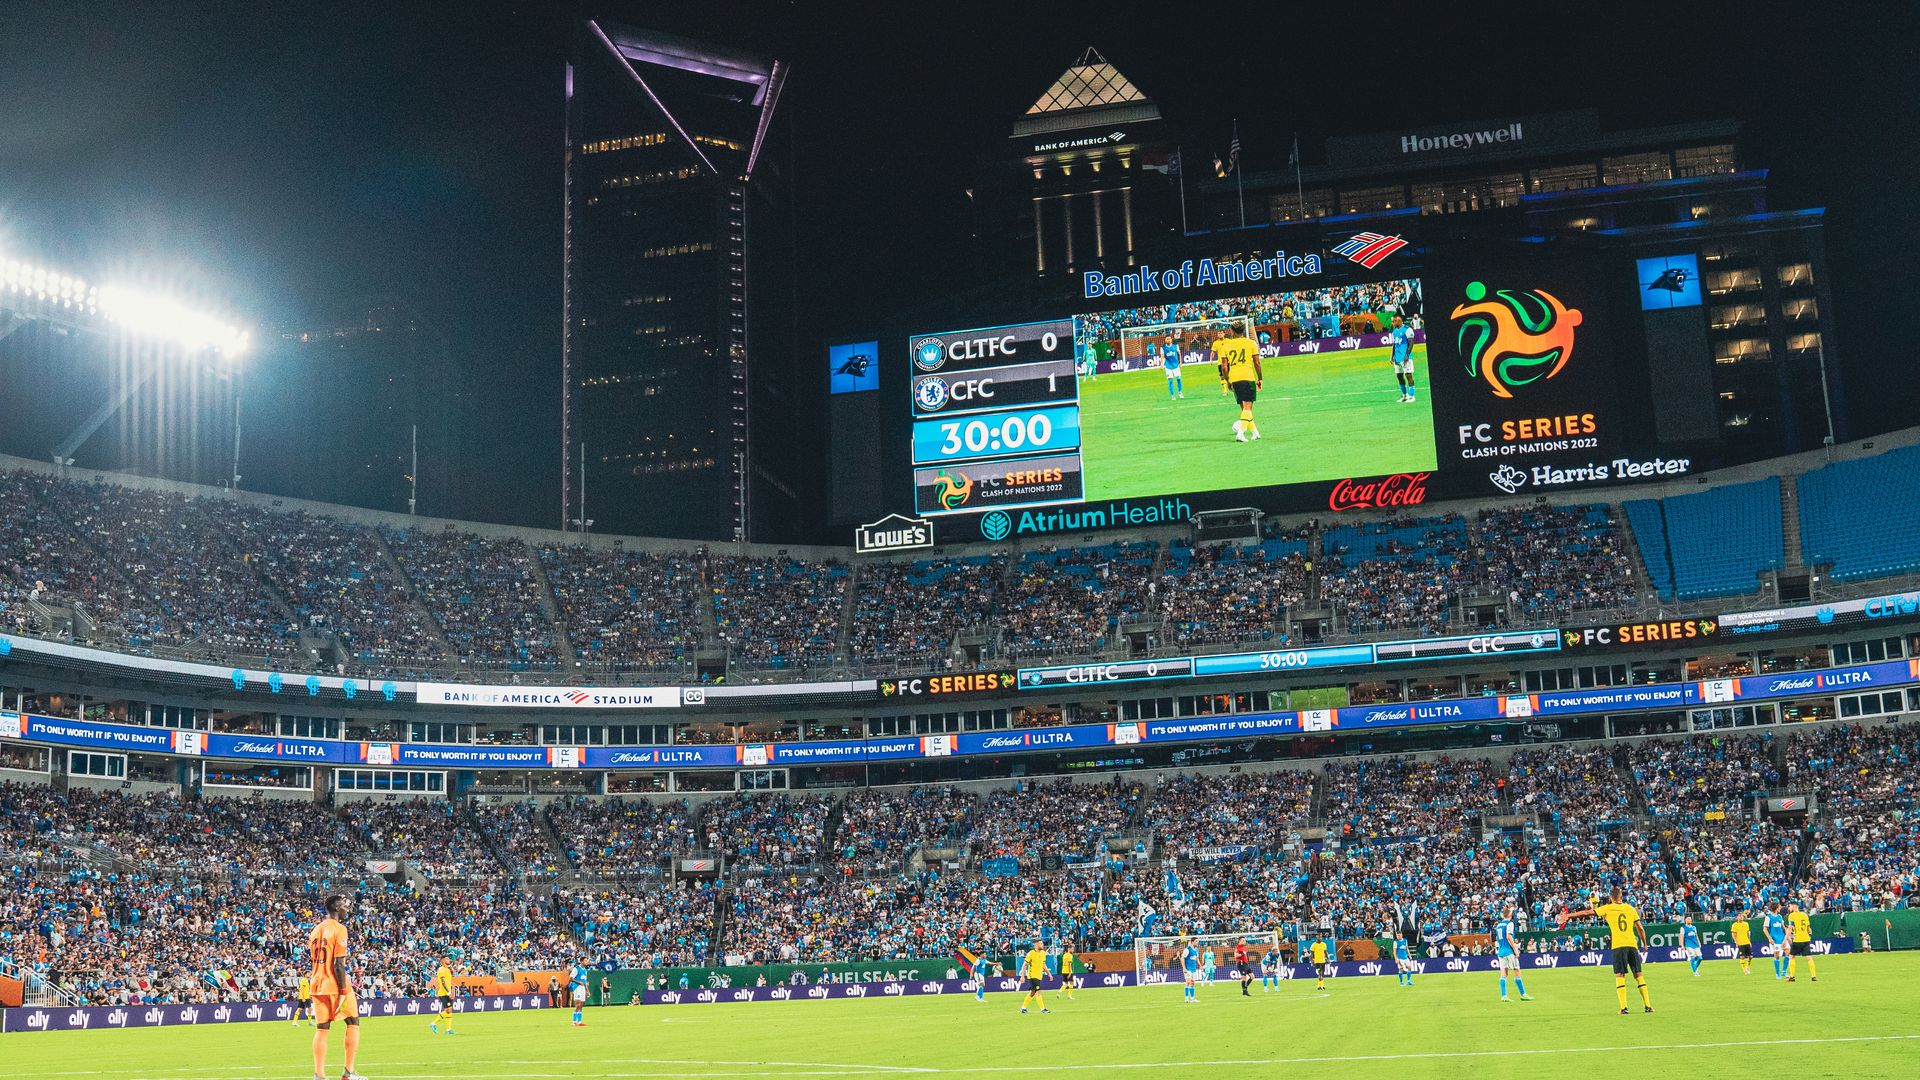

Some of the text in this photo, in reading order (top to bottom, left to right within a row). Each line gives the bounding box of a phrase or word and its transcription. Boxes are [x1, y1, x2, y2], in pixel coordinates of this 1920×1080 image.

[1035, 142, 1057, 151] BANK
[1071, 137, 1108, 147] AMERICA
[1401, 123, 1523, 152] Honeywell
[1084, 250, 1321, 298] Bank of America
[1322, 328, 1333, 338] FC
[948, 332, 1058, 360] CLTFC 0
[1299, 341, 1320, 353] ally
[1339, 336, 1361, 350] ally
[1184, 351, 1204, 363] ally
[1228, 348, 1246, 366] 24
[1111, 359, 1130, 371] ally
[950, 372, 1057, 400] CFC 1
[940, 414, 1052, 455] 30:00
[1459, 413, 1596, 445] FC SERIES
[1462, 438, 1598, 459] CLASH OF NATIONS 2022
[980, 468, 1063, 487] FC SERIES
[1532, 456, 1690, 486] Harris Teeter
[981, 484, 1063, 498] CLASH OF NATIONS 2022
[1329, 472, 1432, 511] Coca-Cola
[1017, 498, 1191, 535] Atrium Health
[1737, 618, 1765, 626] LOCATION
[1584, 620, 1697, 645] FC SERIES
[1411, 636, 1505, 657] 1 CFC
[1260, 652, 1308, 668] 30:00
[1066, 662, 1157, 683] CLTFC 0
[898, 674, 998, 695] FC SERIES
[1769, 672, 1872, 692] Michelob ULTRA
[444, 691, 653, 705] BANK OF AMERICA STADIUM
[685, 690, 703, 702] CC
[1544, 689, 1693, 708] IT'S ONLY WORTH IT IF YOU ENJOY IT
[1365, 706, 1462, 722] Michelob ULTRA
[1152, 726, 1165, 734] IT'S
[1167, 725, 1187, 734] ONLY
[1188, 723, 1218, 732] WORTH
[1228, 722, 1236, 730] IF
[1237, 721, 1255, 730] YOU
[1256, 719, 1283, 728] ENJOY
[1284, 718, 1292, 726] IT
[33, 723, 166, 745] IT'S ONLY WORTH IT IF YOU ENJOY IT
[982, 733, 1073, 748] Michelob ULTRA
[234, 741, 325, 756] Michelob ULTRA
[404, 750, 542, 761] IT'S ONLY WORTH IT IF YOU ENJOY IT
[611, 752, 702, 763] Michelob ULTRA
[1617, 913, 1628, 932] 6
[1702, 931, 1726, 945] FC
[1715, 945, 1739, 959] ally
[1810, 941, 1831, 954] ally
[1447, 958, 1470, 972] ally
[1535, 954, 1558, 968] ally
[1580, 952, 1603, 966] ally
[898, 969, 919, 981] FC
[1359, 962, 1382, 976] ally
[1000, 978, 1021, 991] ally
[1104, 973, 1125, 987] ally
[1145, 971, 1167, 984] ally
[808, 986, 829, 999] ally
[846, 985, 867, 998] ally
[922, 981, 943, 994] ally
[531, 995, 541, 1010] ally
[661, 991, 681, 1004] ally
[734, 989, 754, 1002] ally
[276, 1004, 292, 1020] ally
[359, 1001, 372, 1017] ally
[384, 1000, 397, 1016] ally
[430, 998, 442, 1014] ally
[474, 997, 485, 1012] ally
[27, 1011, 50, 1030] ally
[69, 1009, 90, 1029] ally
[180, 1007, 199, 1024] ally
[246, 1005, 263, 1021] ally
